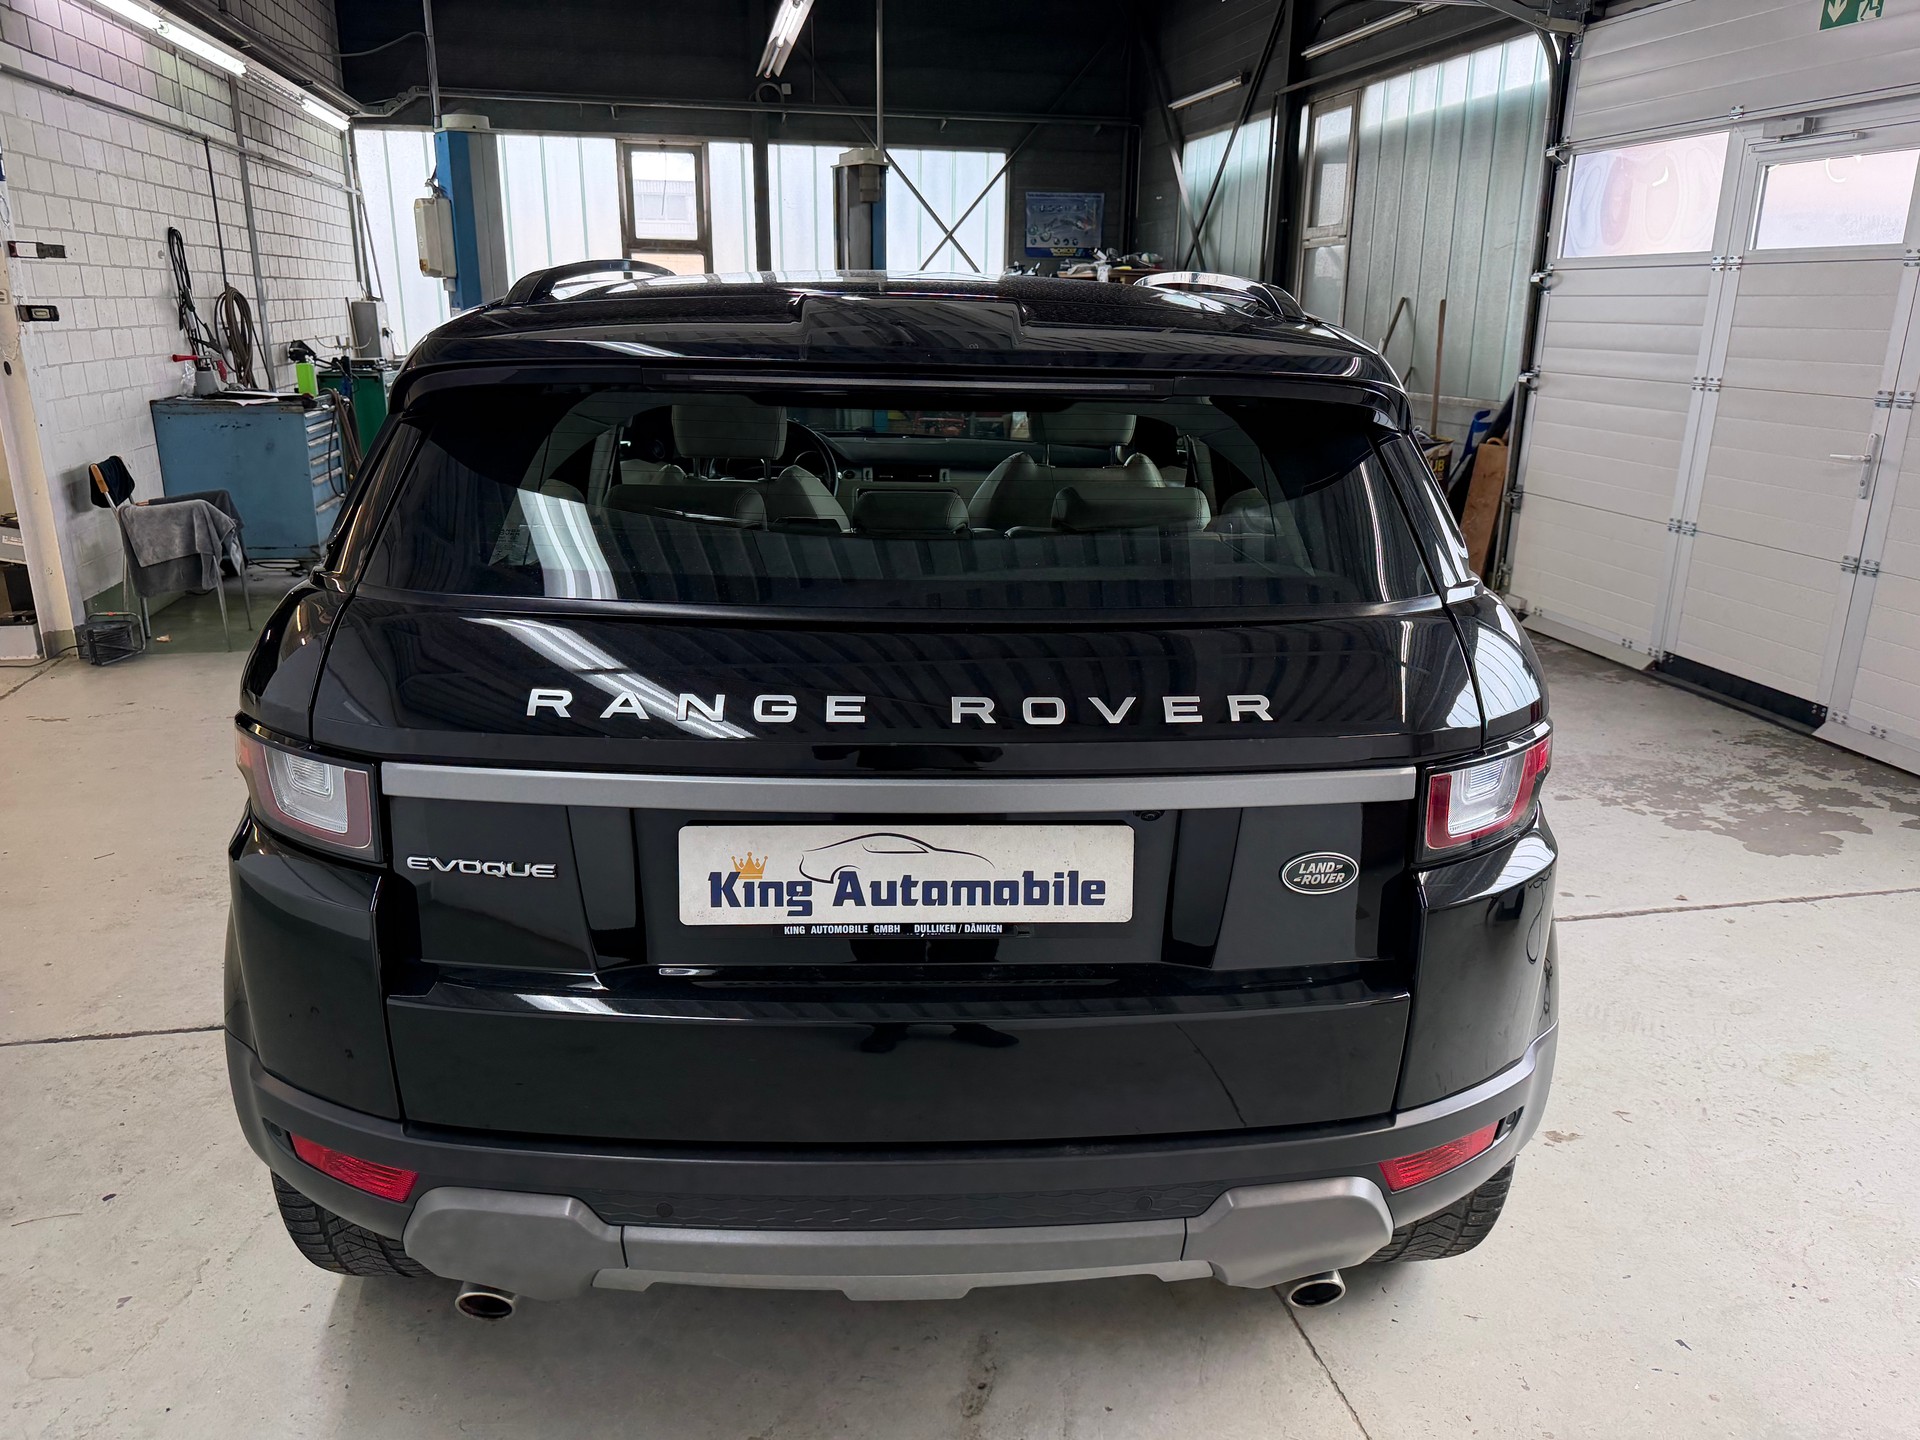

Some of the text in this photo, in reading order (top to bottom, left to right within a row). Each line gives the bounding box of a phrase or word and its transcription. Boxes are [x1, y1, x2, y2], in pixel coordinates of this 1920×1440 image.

[526, 688, 1274, 724] RANGE ROVER
[406, 856, 556, 878] EVOQUE
[1299, 862, 1335, 874] LAND
[1301, 872, 1345, 885] ROVER
[708, 870, 1106, 917] King Automobile
[784, 925, 806, 935] KING
[810, 924, 868, 934] AUTOMOBILE
[873, 924, 901, 933] GMBH
[914, 923, 957, 933] DULLIKEN
[964, 922, 1003, 933] DÄNIKEN
